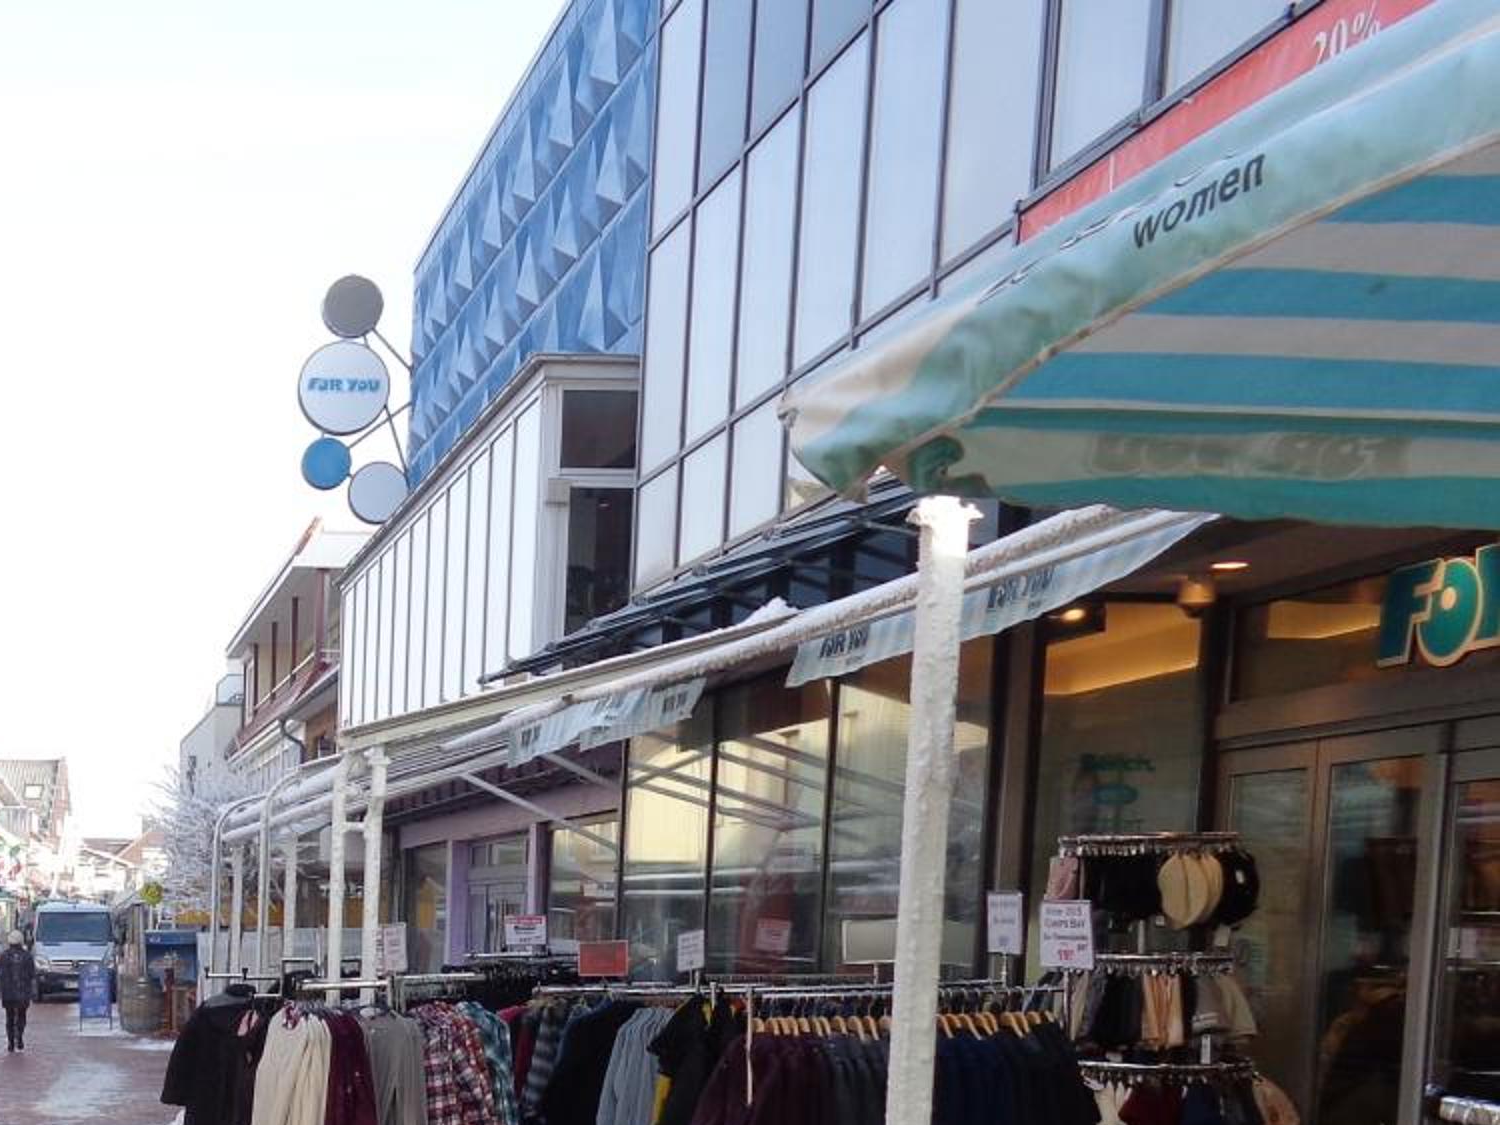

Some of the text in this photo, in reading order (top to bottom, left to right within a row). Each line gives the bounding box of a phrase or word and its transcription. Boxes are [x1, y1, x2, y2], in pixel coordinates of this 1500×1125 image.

[1134, 153, 1266, 249] women
[308, 377, 381, 392] FOR YOU
